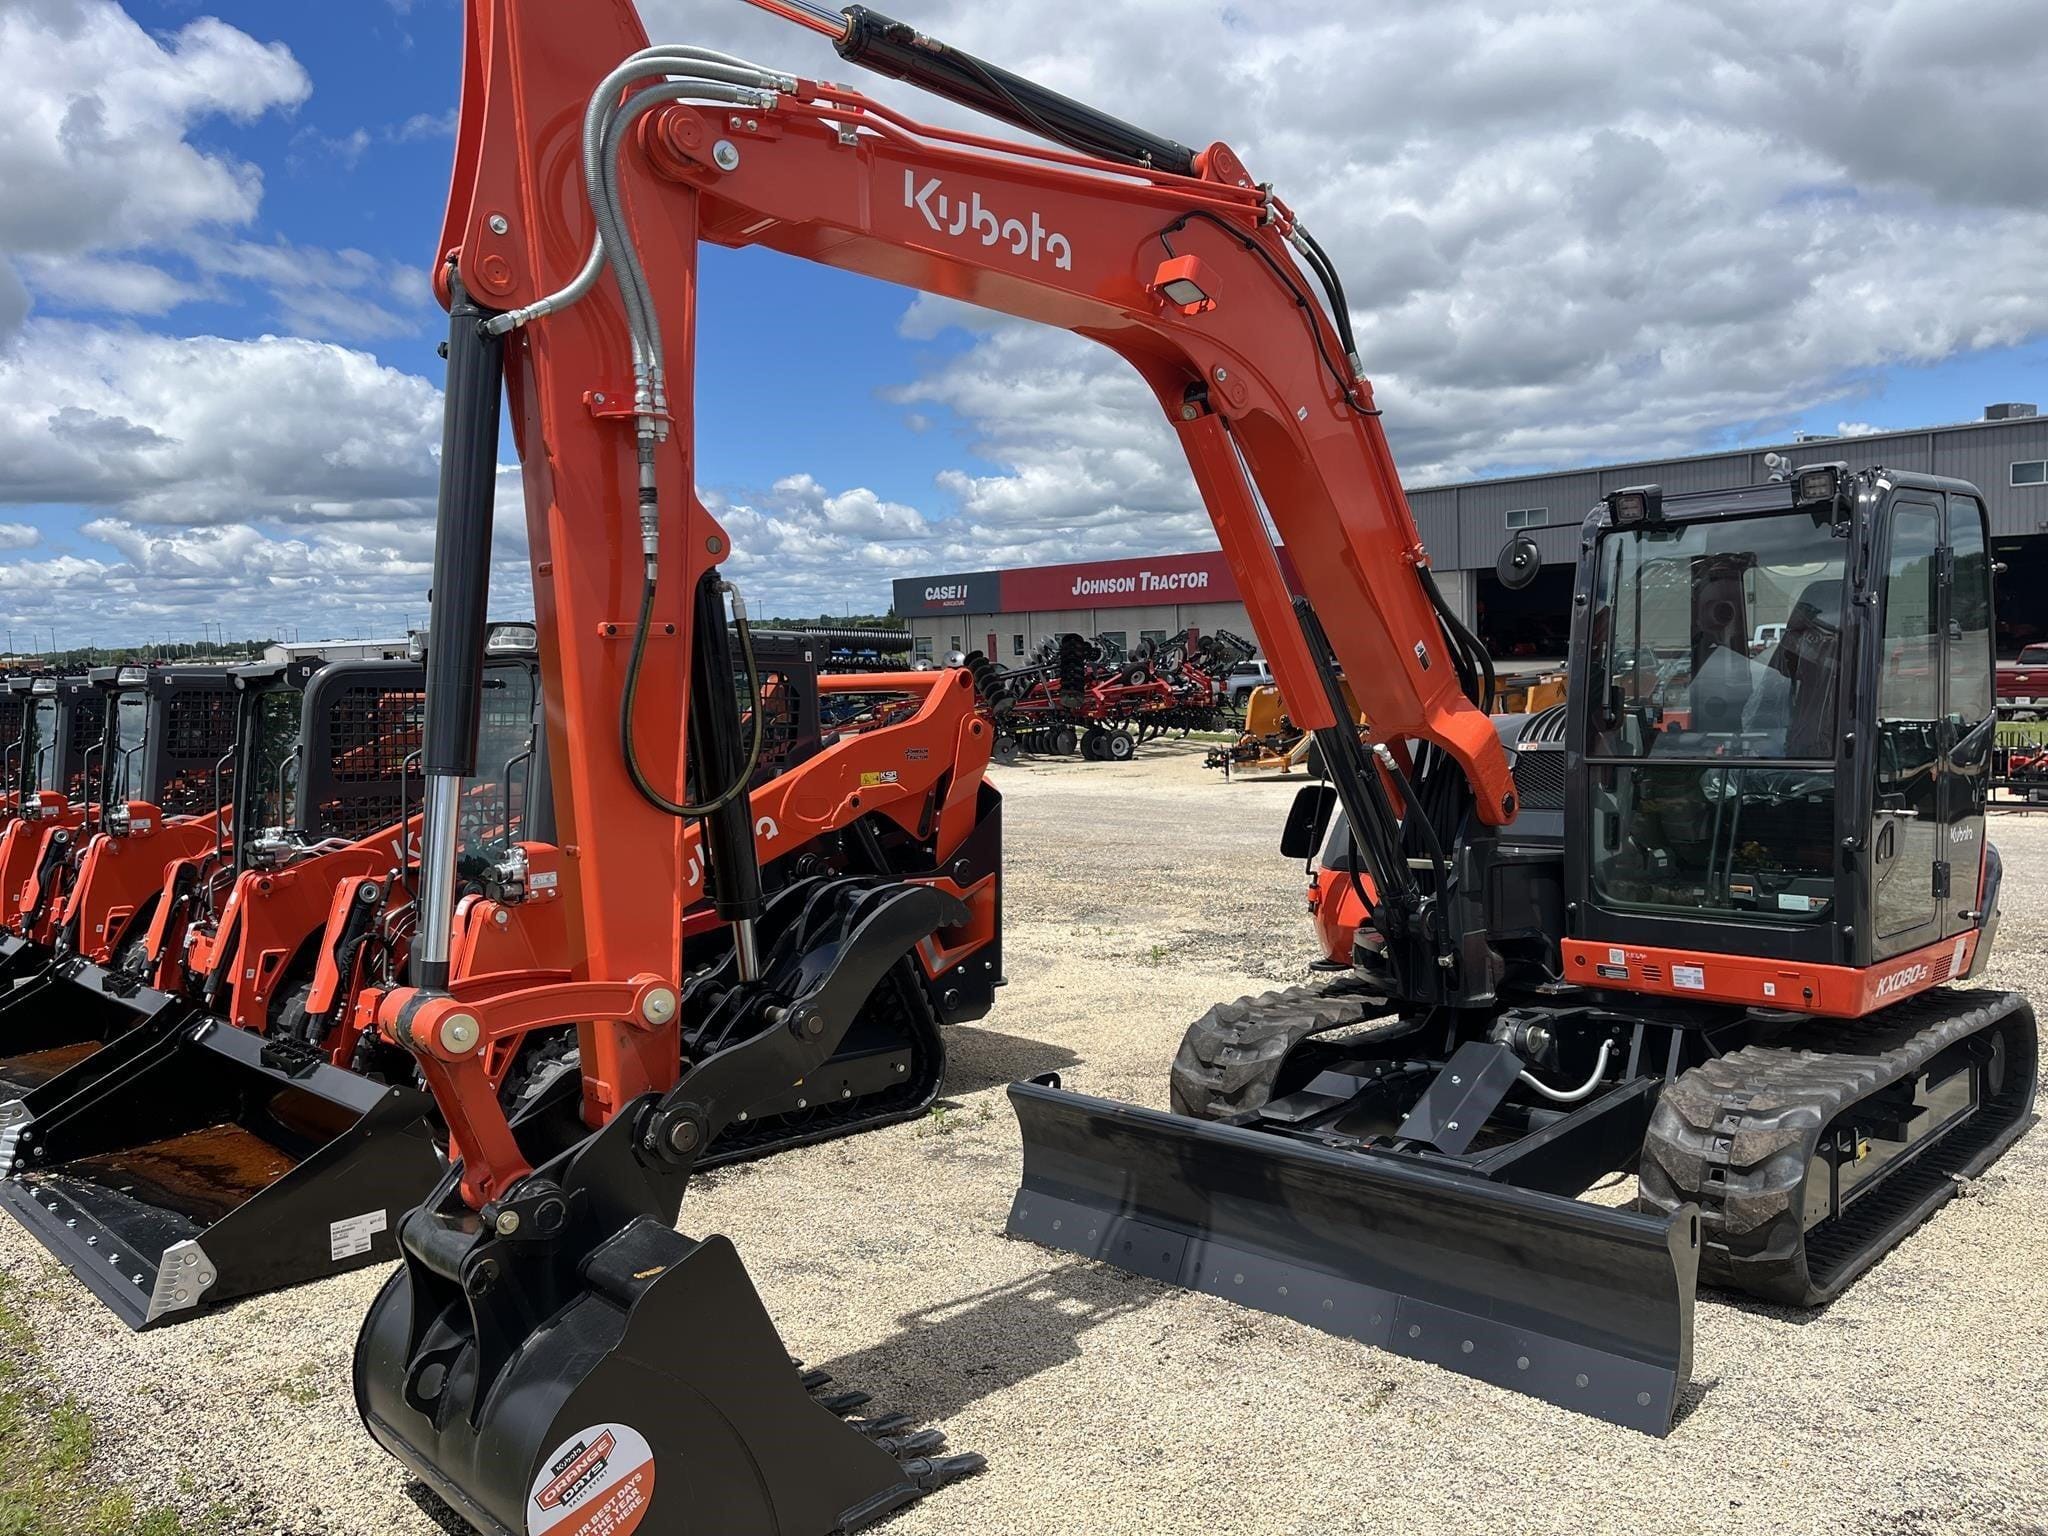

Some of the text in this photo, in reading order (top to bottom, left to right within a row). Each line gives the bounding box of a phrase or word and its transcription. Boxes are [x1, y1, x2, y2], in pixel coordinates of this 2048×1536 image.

[904, 169, 1072, 271] Kubota
[925, 586, 956, 600] CASE
[1072, 572, 1208, 595] JOHNSON TRACTOR
[1951, 825, 1972, 843] Kubota
[544, 1439, 609, 1502] ORANGE
[555, 1447, 582, 1471] Kubota
[563, 1461, 604, 1501] DAYS
[588, 1470, 608, 1489] EVENT
[590, 1497, 616, 1525] BEST
[617, 1472, 642, 1499] DAYS
[612, 1487, 640, 1514] YEAR
[615, 1496, 646, 1524] HERE.
